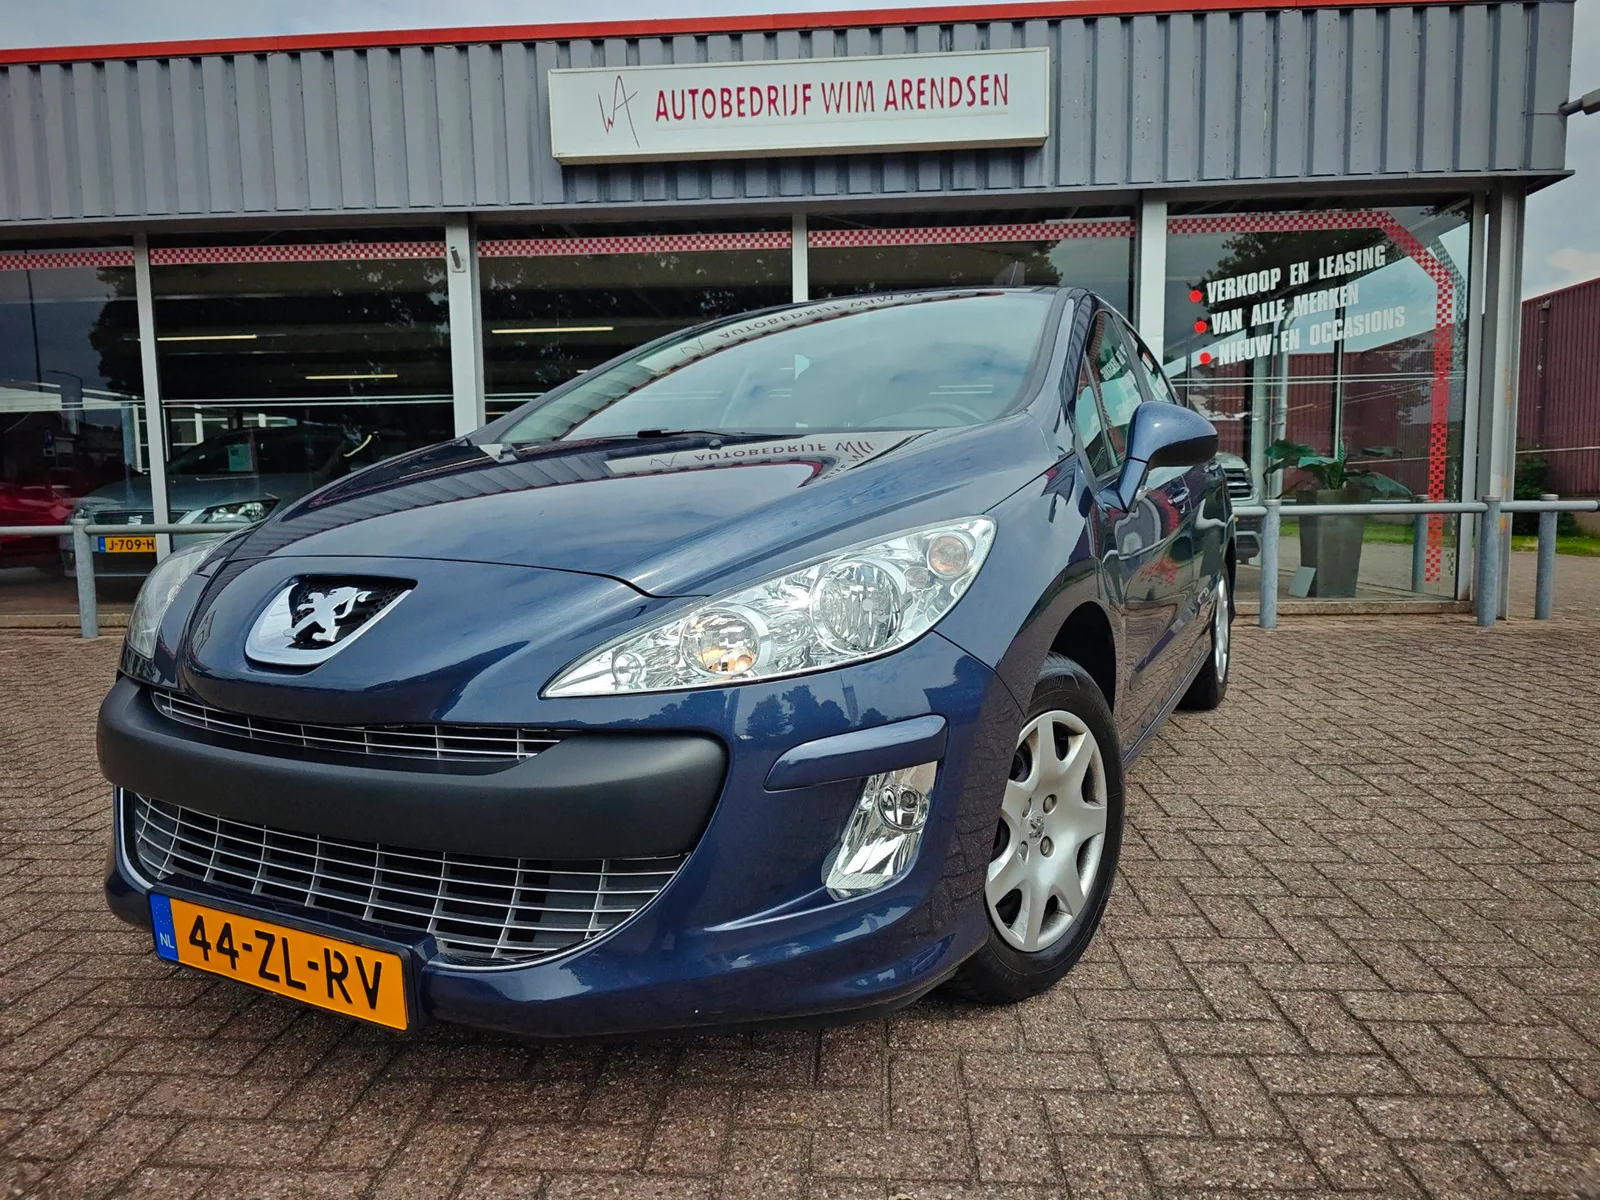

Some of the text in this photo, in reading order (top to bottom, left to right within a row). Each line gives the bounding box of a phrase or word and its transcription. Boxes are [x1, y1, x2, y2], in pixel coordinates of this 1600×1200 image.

[655, 73, 1009, 122] AUTOBEDRIJF WIM ARENDSEN
[1207, 245, 1386, 304] VERKOOP EN LEASING
[1211, 283, 1359, 335] VAN ALLE MERKEN
[1218, 306, 1406, 366] NIEUW EN OCCASIONS
[109, 539, 155, 550] J-709-H
[159, 915, 382, 1010] NL 44-ZL-RV
